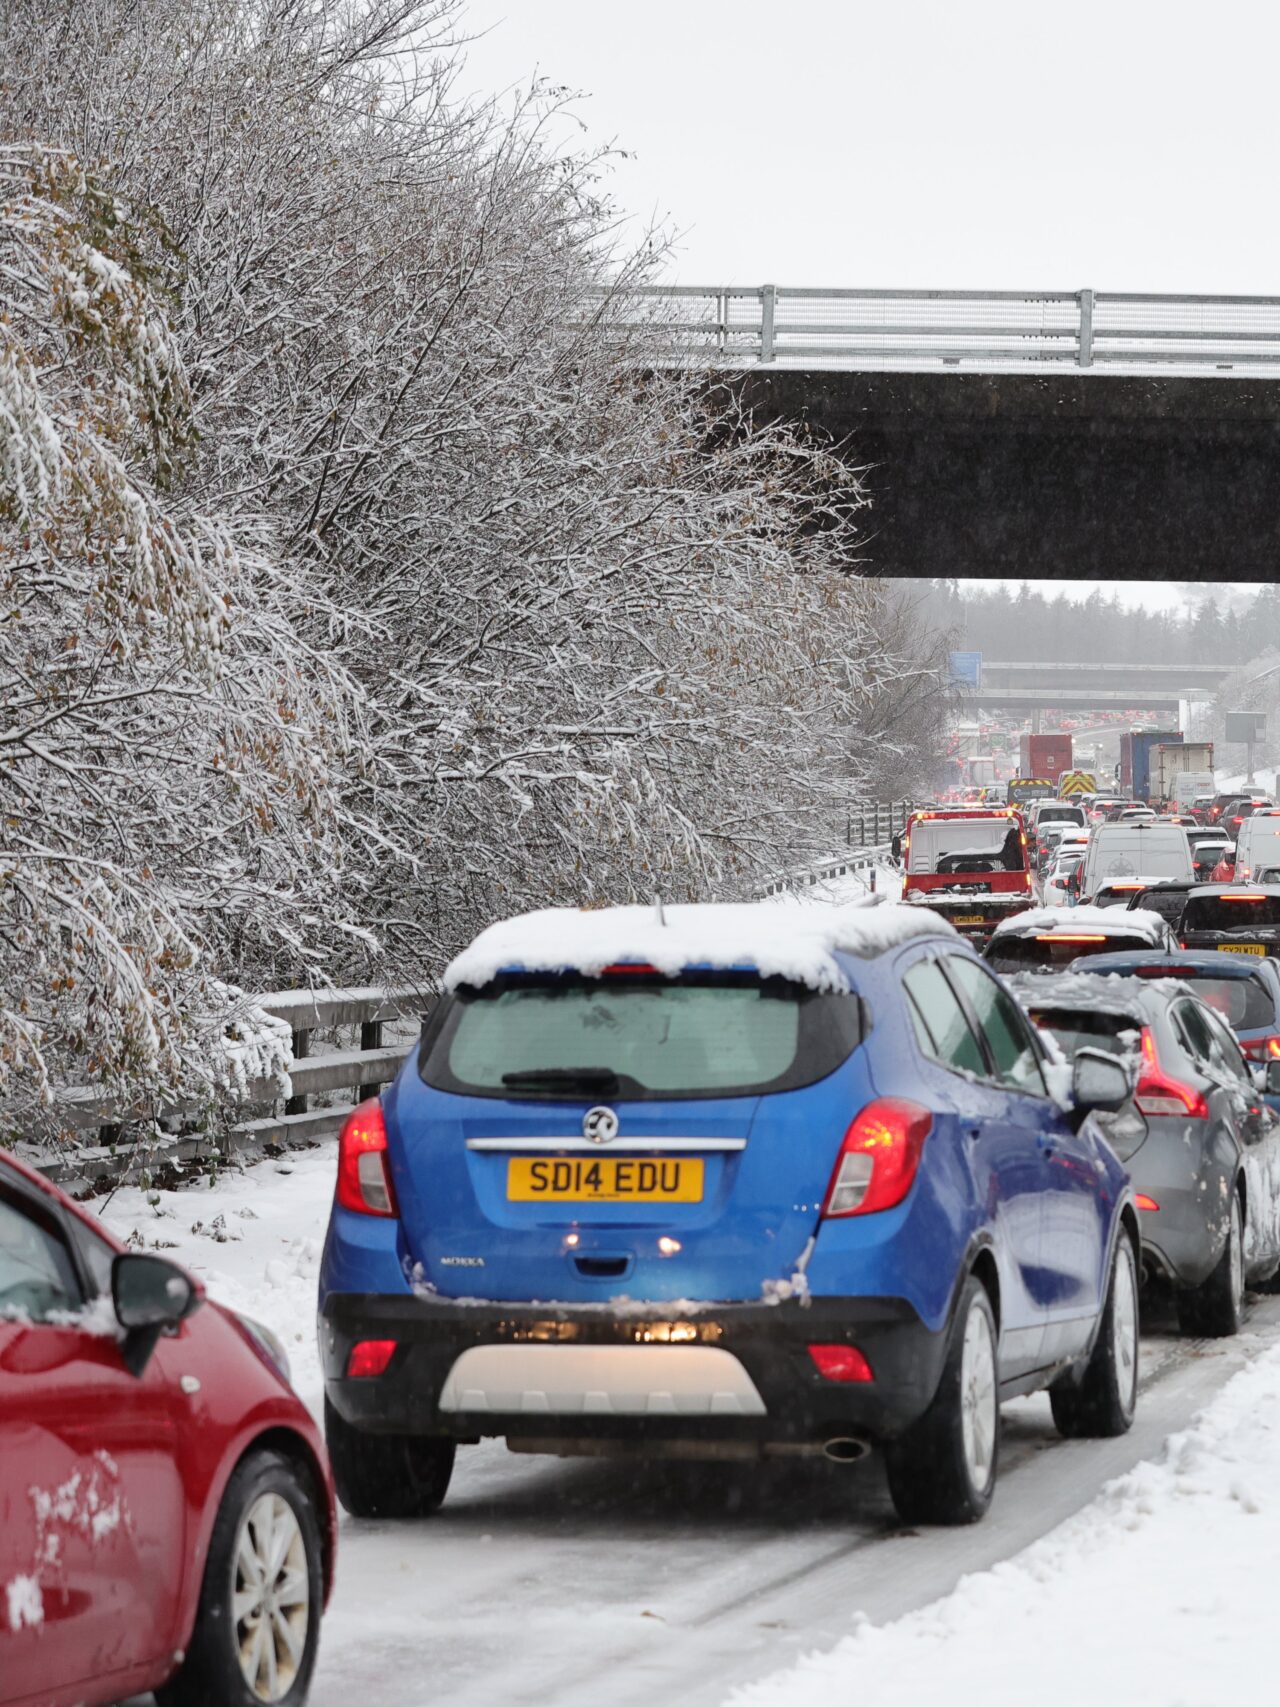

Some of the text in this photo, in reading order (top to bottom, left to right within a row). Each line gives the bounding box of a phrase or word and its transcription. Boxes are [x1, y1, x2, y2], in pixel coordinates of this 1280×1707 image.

[530, 1161, 680, 1192] SD14 EDU
[440, 1257, 485, 1267] MOKKA
